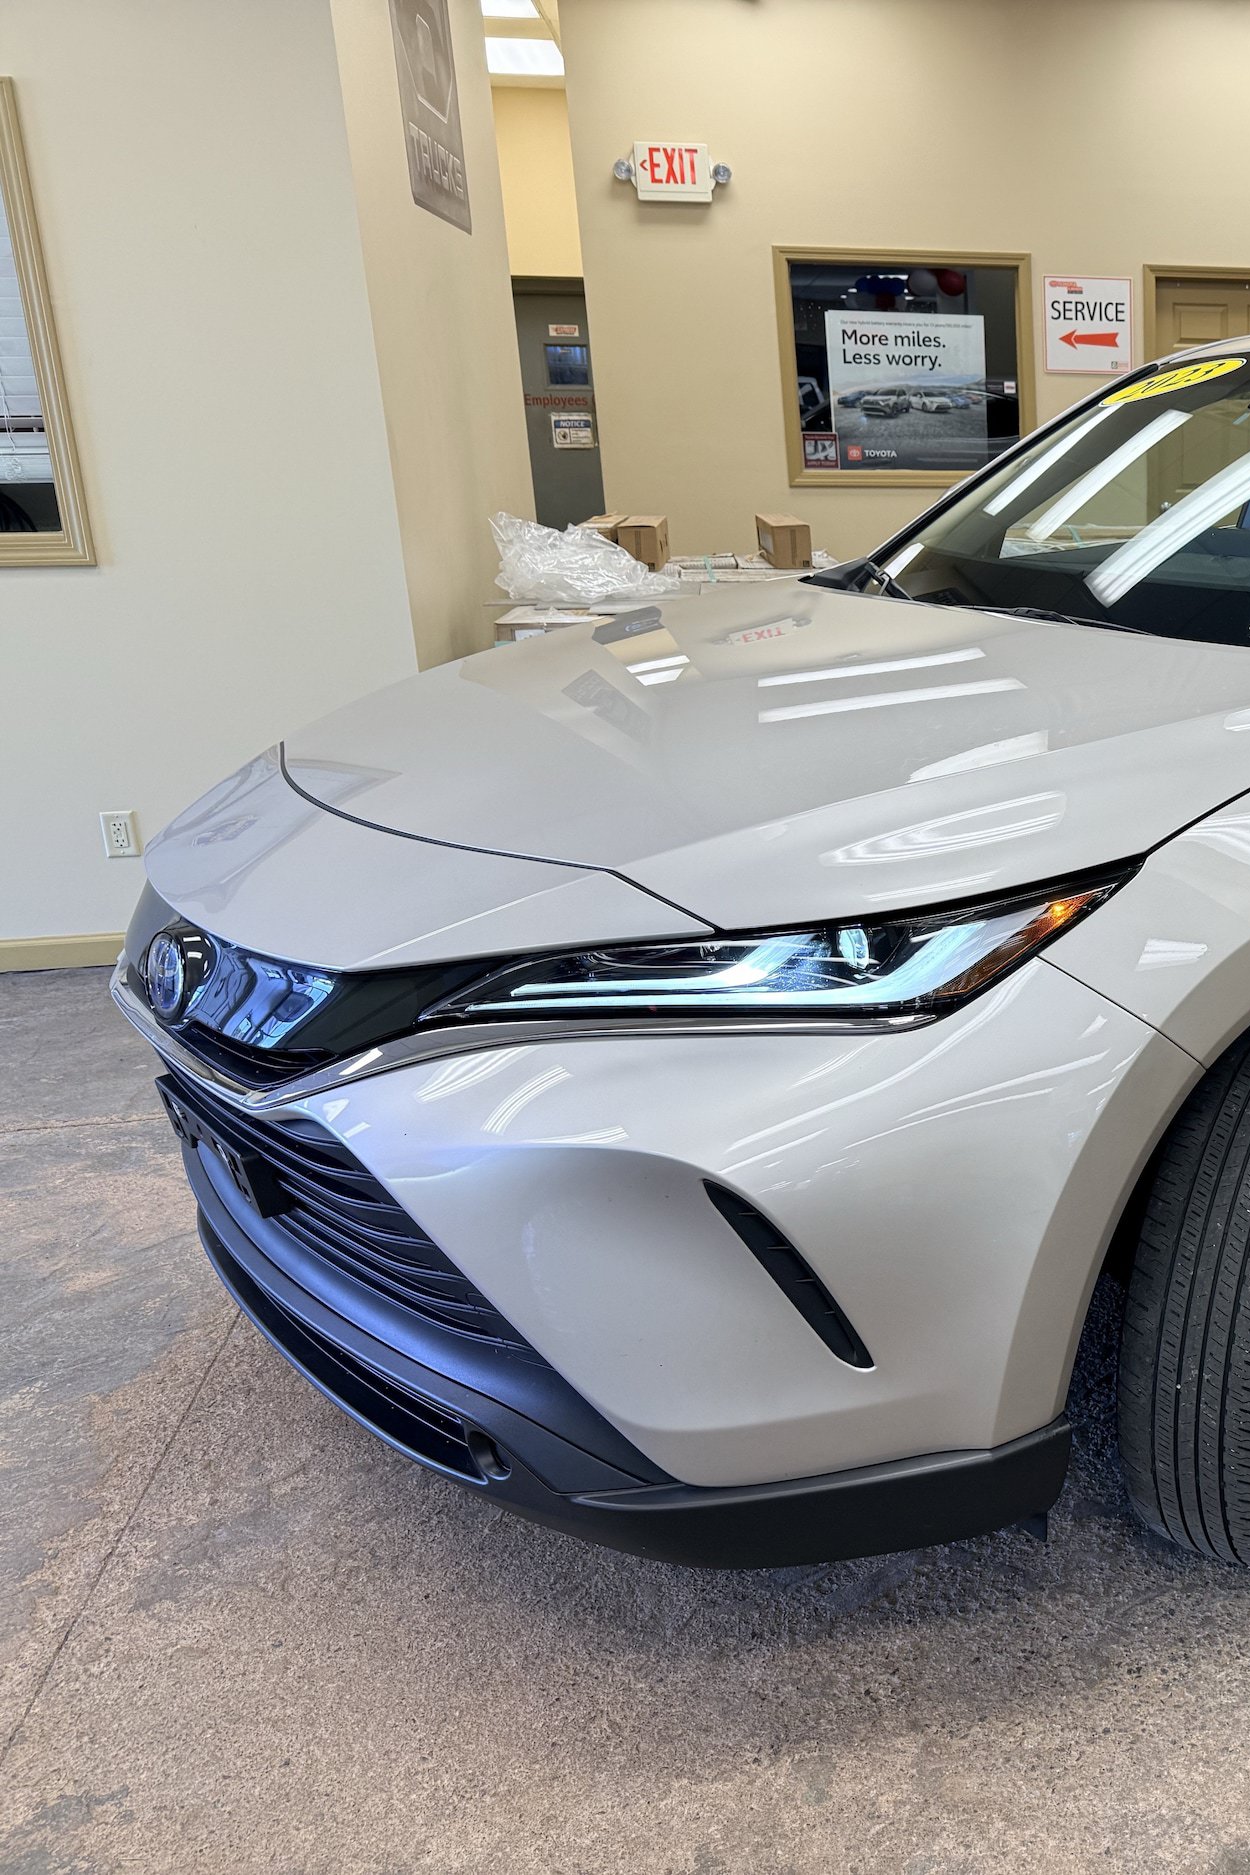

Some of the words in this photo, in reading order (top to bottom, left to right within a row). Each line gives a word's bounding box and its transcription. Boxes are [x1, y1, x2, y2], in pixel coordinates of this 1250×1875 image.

[648, 147, 698, 184] EXIT
[1051, 300, 1125, 322] SERVICE
[842, 330, 888, 346] More
[894, 331, 946, 348] miles.
[843, 349, 881, 365] Less
[886, 354, 942, 371] worry.
[524, 394, 588, 408] Employees
